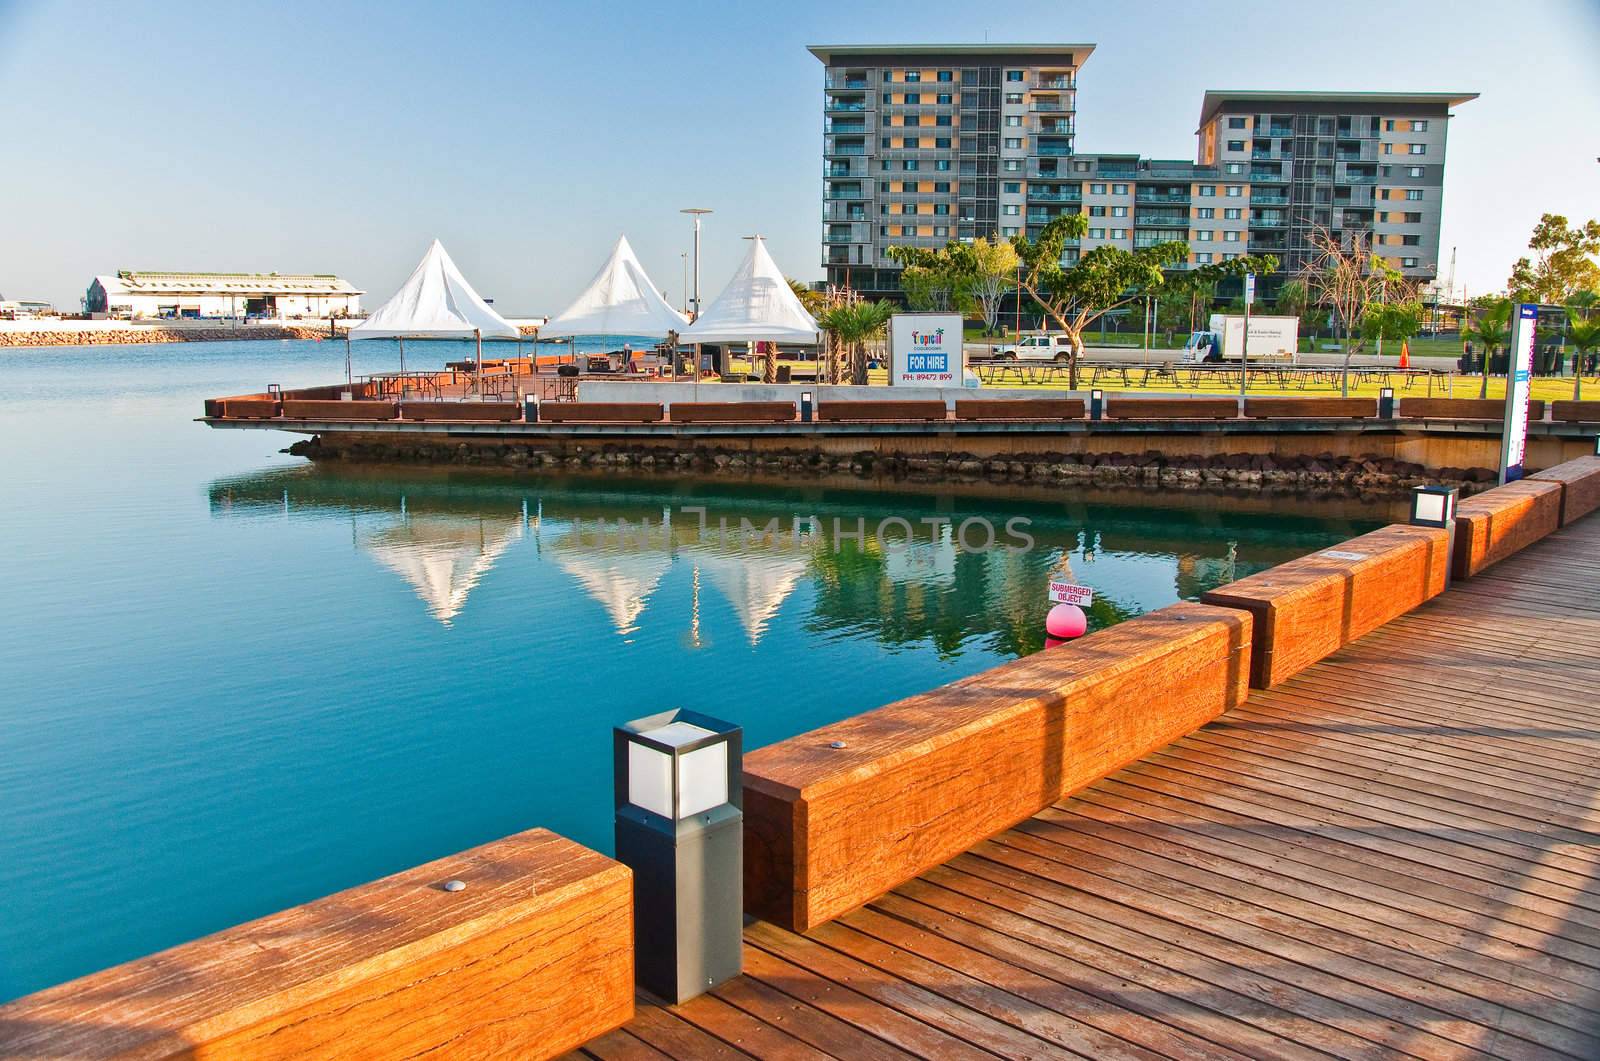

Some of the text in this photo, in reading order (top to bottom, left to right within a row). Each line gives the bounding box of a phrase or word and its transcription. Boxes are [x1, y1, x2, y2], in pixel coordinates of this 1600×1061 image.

[909, 356, 945, 370] FOR HIRE
[1052, 583, 1091, 596] SUBMERGED
[1058, 593, 1082, 603] OBJECT
